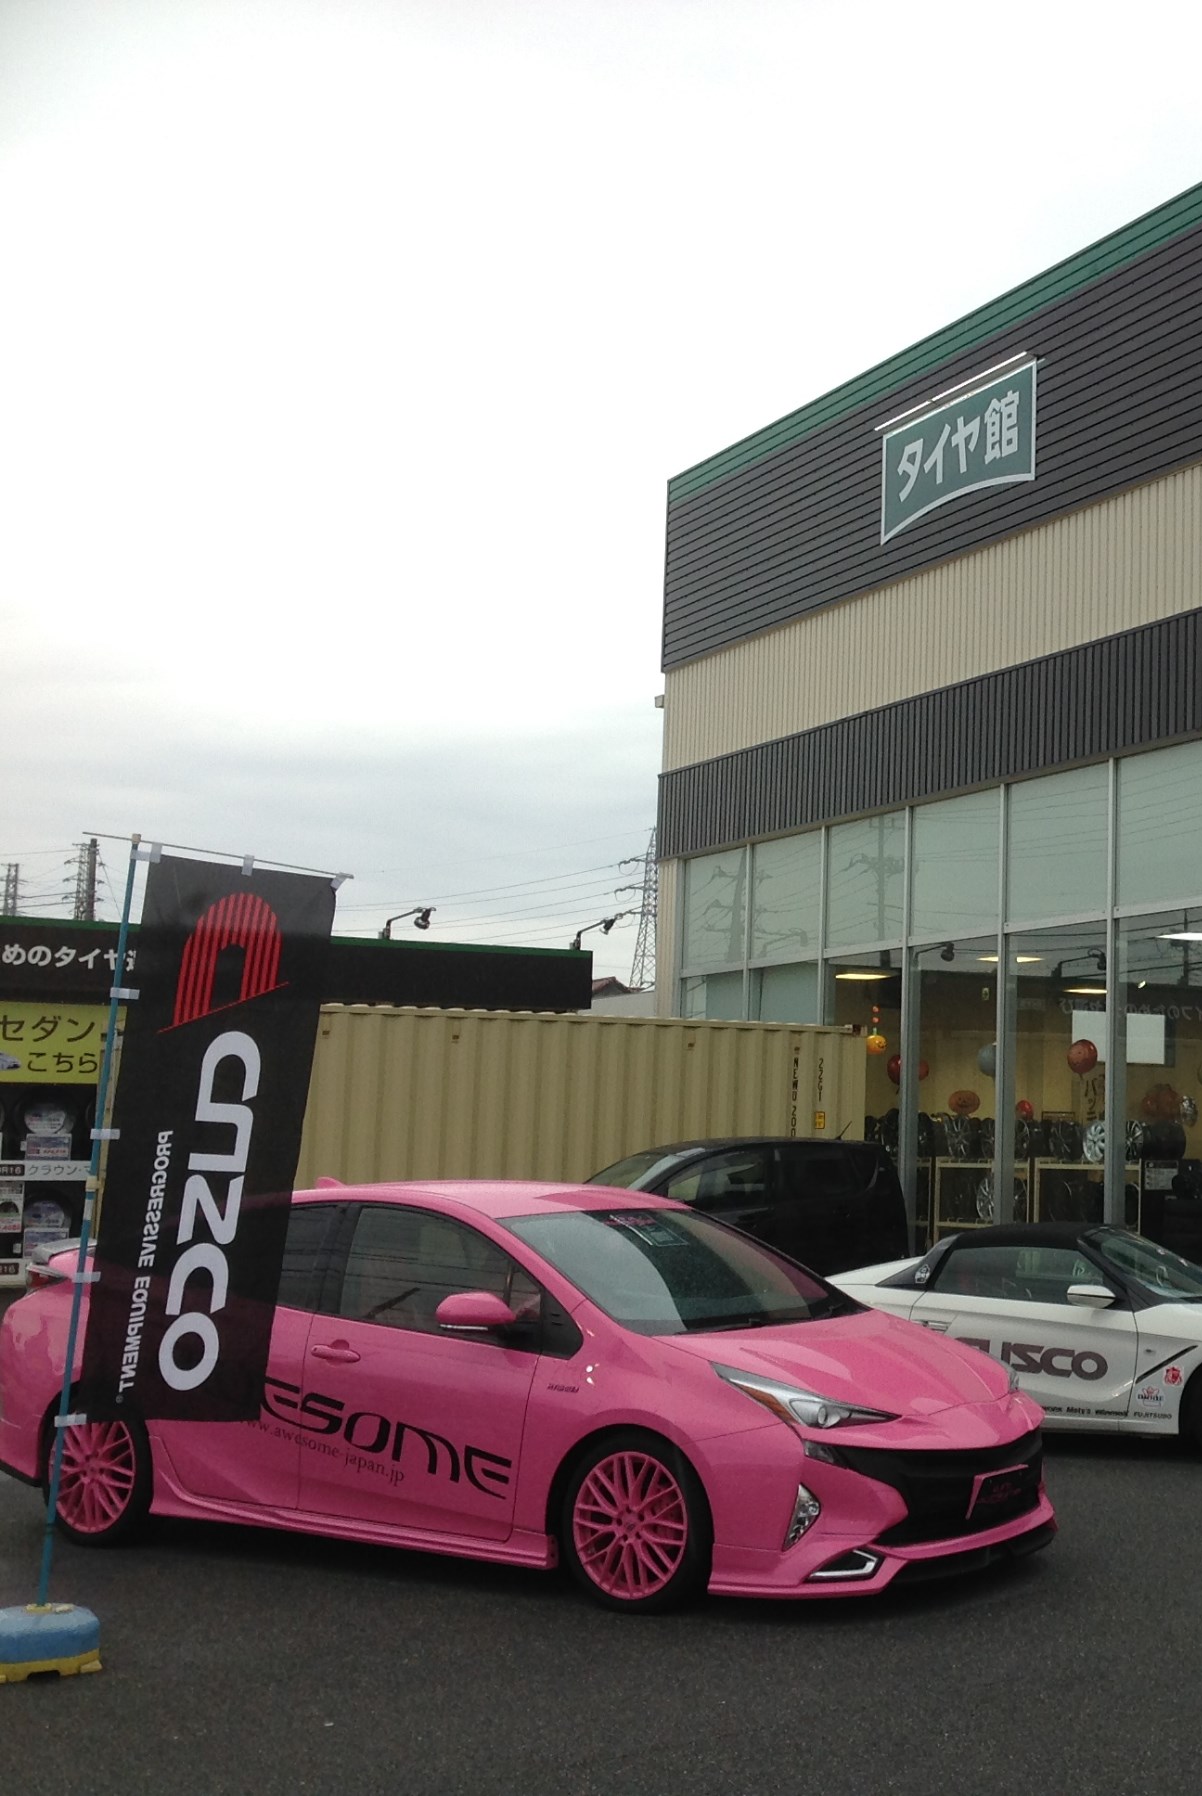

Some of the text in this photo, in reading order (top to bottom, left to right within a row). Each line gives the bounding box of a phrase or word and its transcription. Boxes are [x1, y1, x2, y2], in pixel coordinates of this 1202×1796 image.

[897, 390, 1020, 503] タイヤ館
[0, 1014, 96, 1043] セダン
[27, 1051, 99, 1074] こちら
[955, 1336, 1108, 1381] USCO
[239, 1418, 405, 1487] ww.awesome-japan.jp
